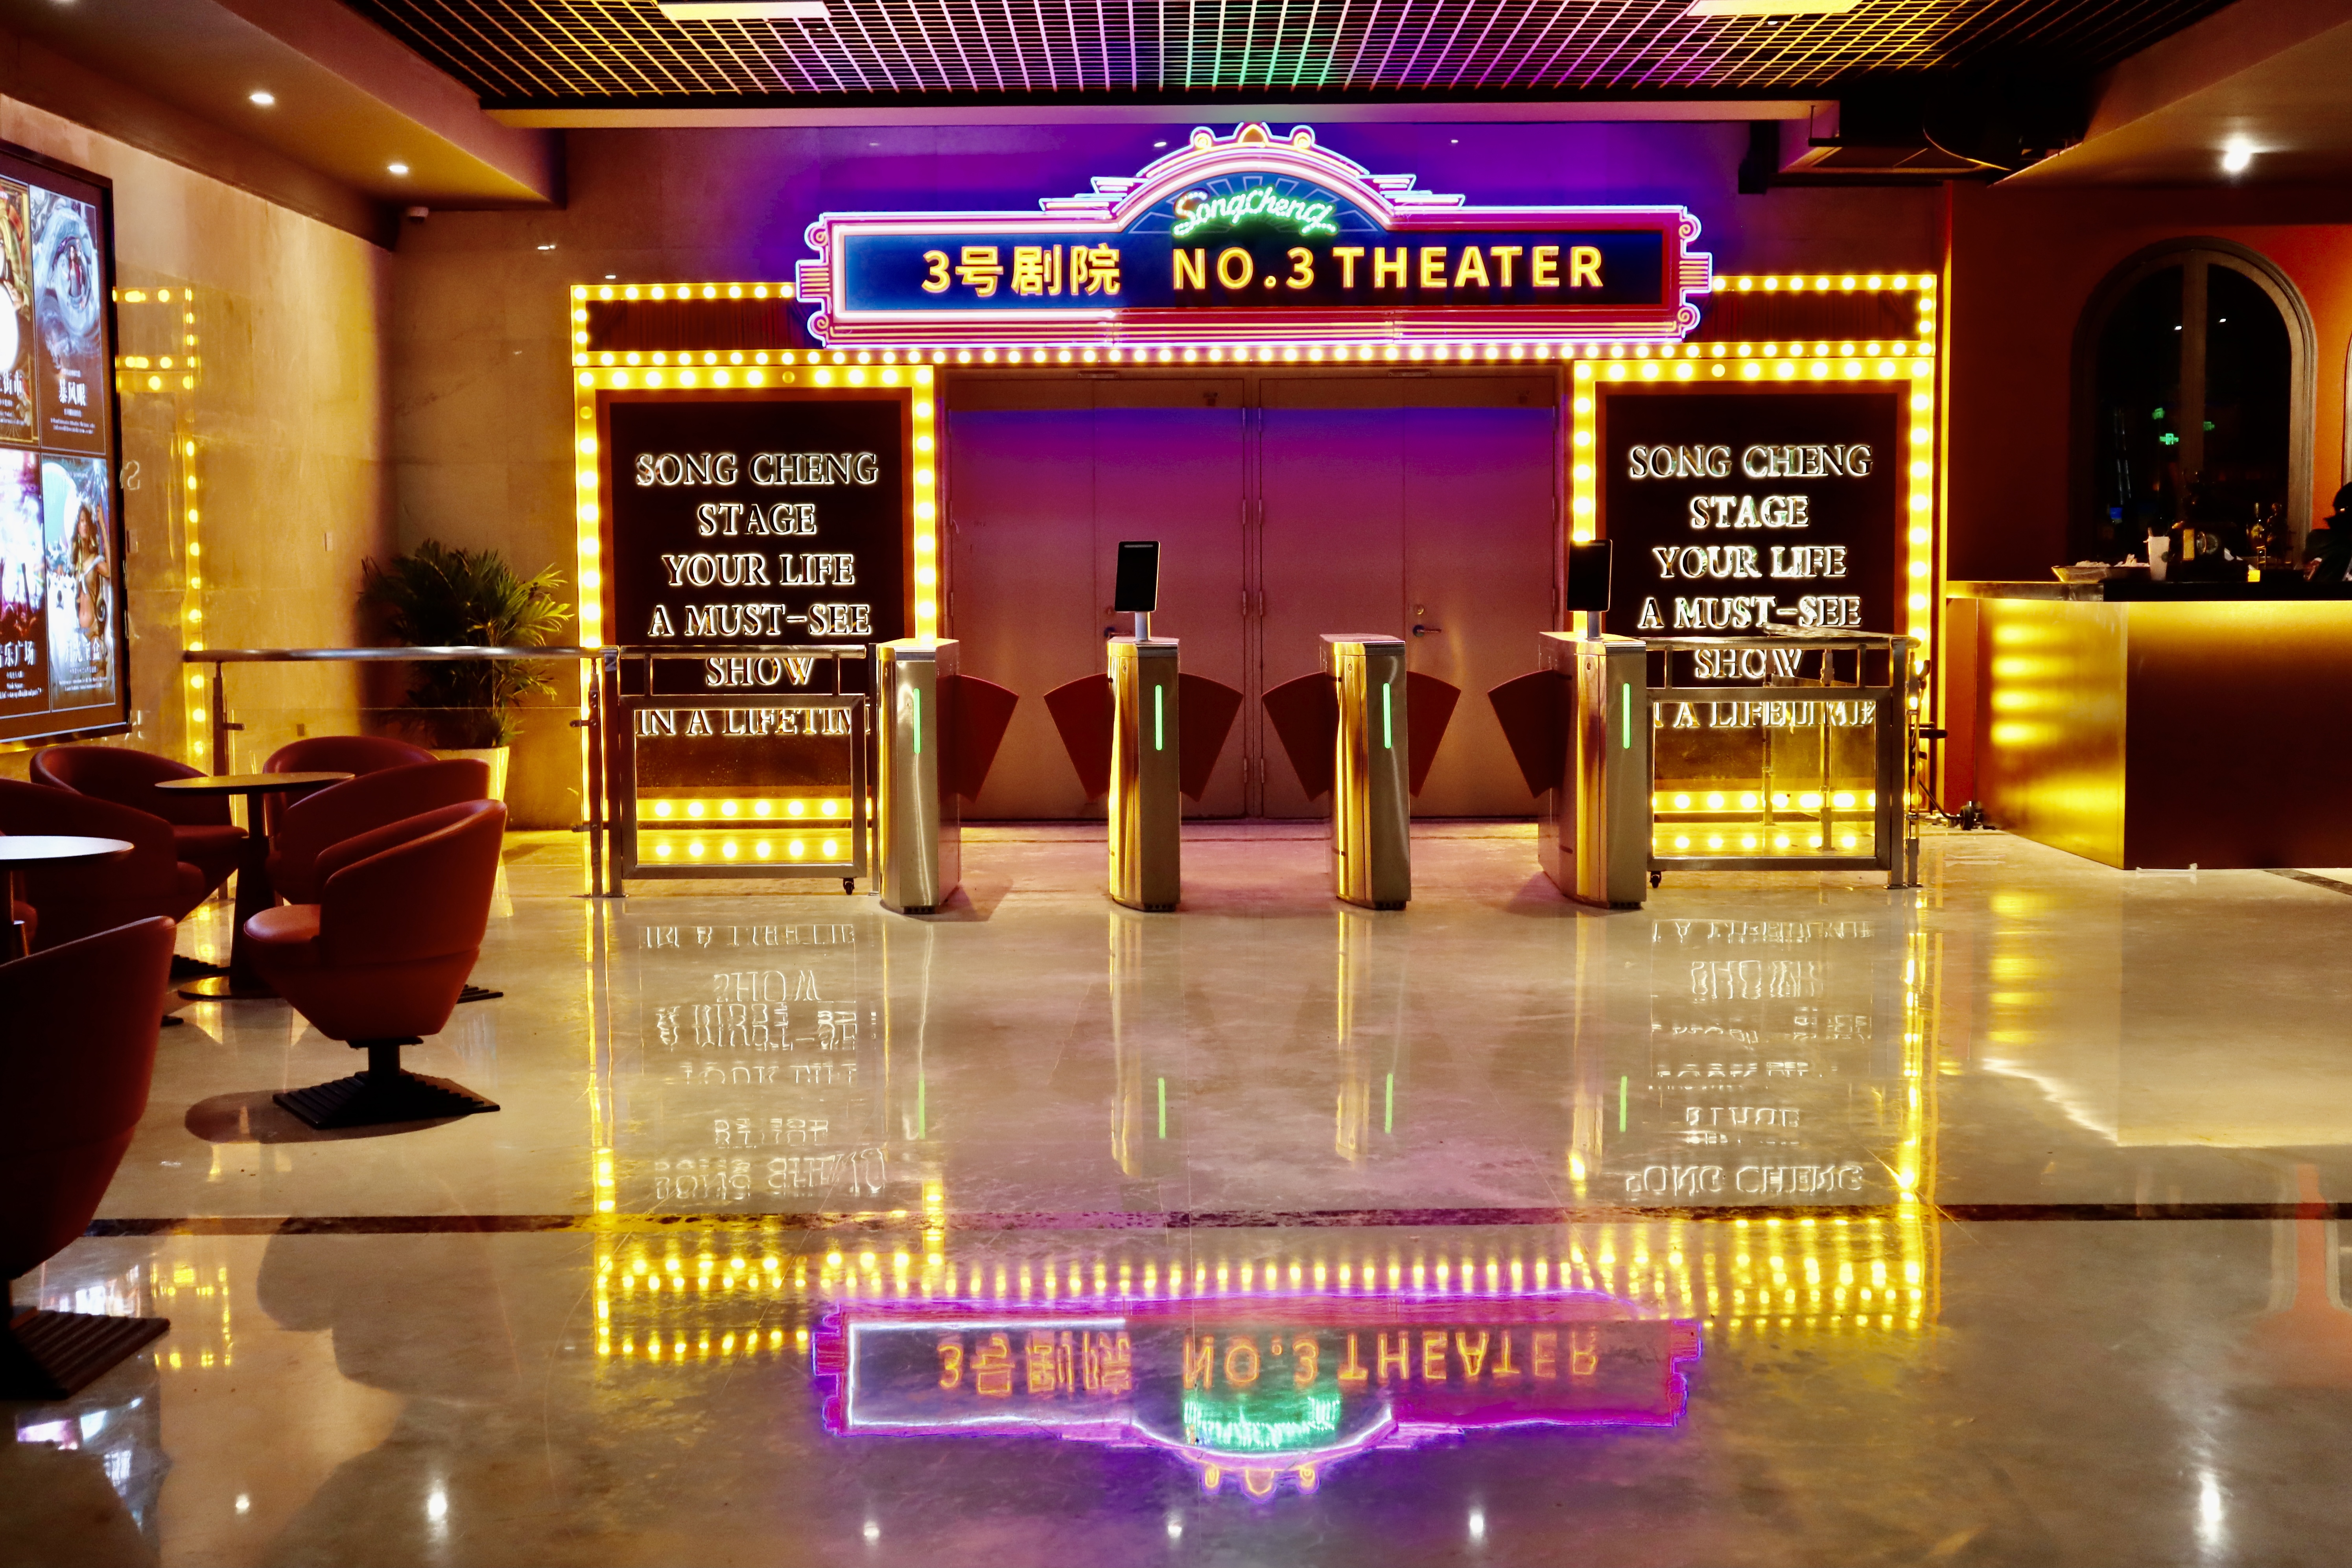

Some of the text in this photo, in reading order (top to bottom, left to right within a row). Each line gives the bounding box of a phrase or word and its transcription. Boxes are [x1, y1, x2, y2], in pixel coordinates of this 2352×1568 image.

[921, 243, 1121, 296] 3号剧院
[1172, 245, 1605, 290] NO.3 THEATER
[59, 378, 87, 406] 暴风眼
[636, 452, 879, 485] SONG CHENG
[1629, 444, 1873, 478] SONG CHENG
[697, 503, 817, 536] STAGE
[1690, 495, 1809, 529] STAGE
[662, 553, 856, 586] YOUR LIFE
[1653, 545, 1847, 578] YOUR LIFE
[647, 603, 872, 636] A MUST-SEE
[1638, 595, 1862, 629] A MUST-SEE
[706, 657, 814, 686] SHOW
[1695, 649, 1803, 679] SHOW
[636, 709, 871, 736] IN A LIFETIM
[1672, 701, 1701, 728] A
